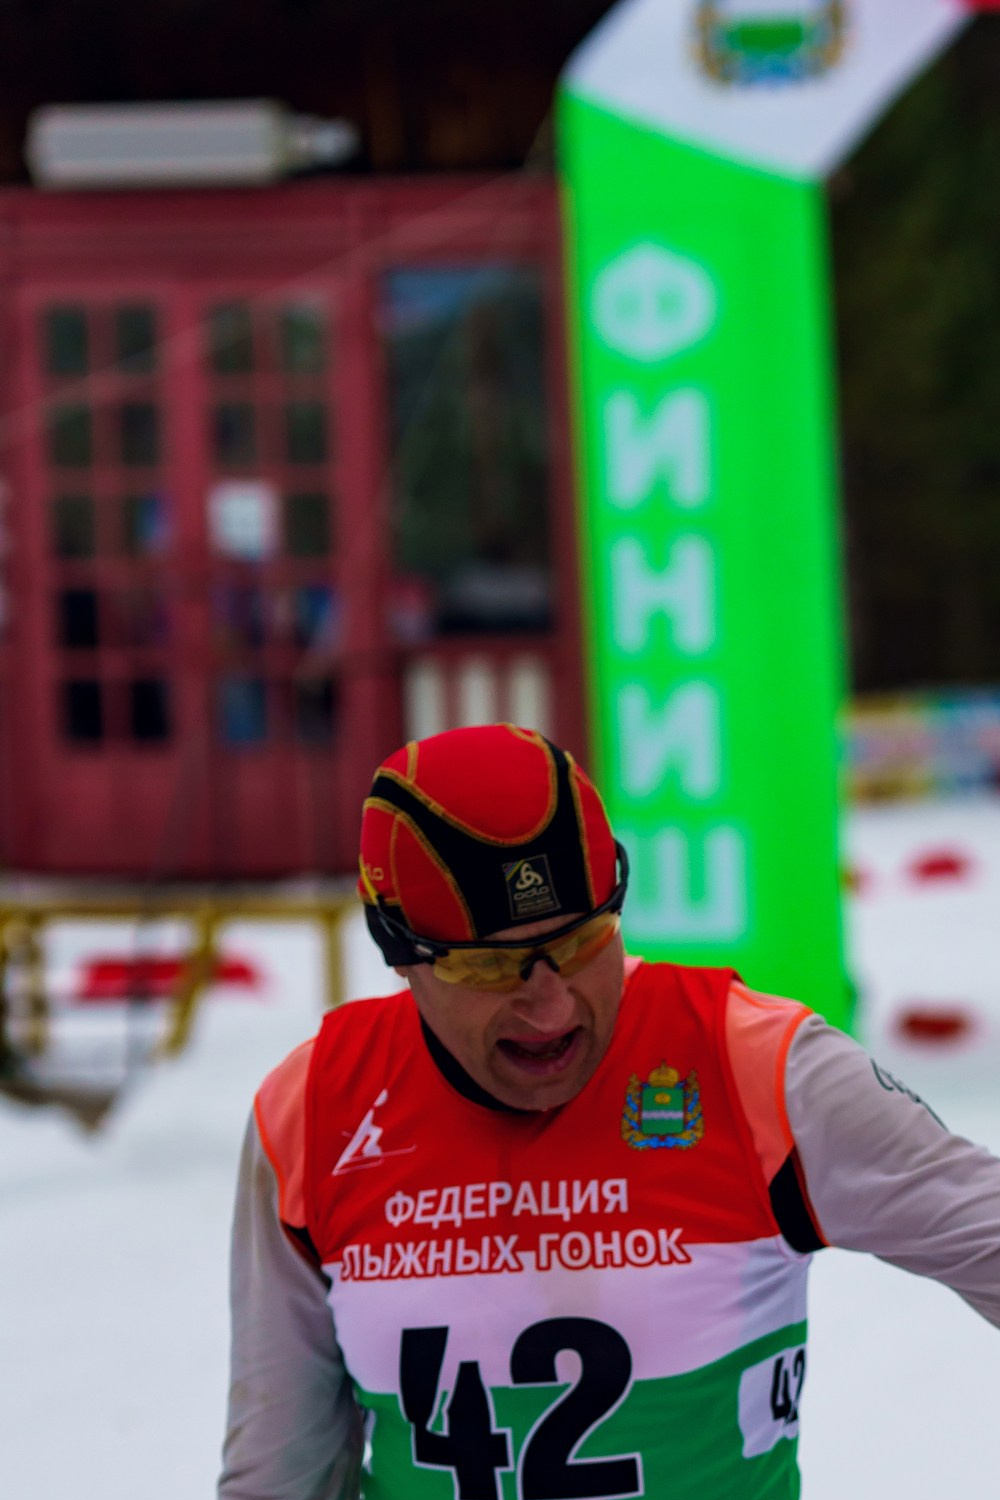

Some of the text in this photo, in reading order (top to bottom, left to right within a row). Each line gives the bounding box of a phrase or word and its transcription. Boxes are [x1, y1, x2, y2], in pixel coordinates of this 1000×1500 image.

[592, 242, 747, 944] ФИНИШ
[384, 1177, 629, 1227] ФЕДЕРАЦИЯ
[342, 1227, 691, 1281] ЛЫЖНЫХ ГОНОК
[770, 1347, 806, 1425] 42
